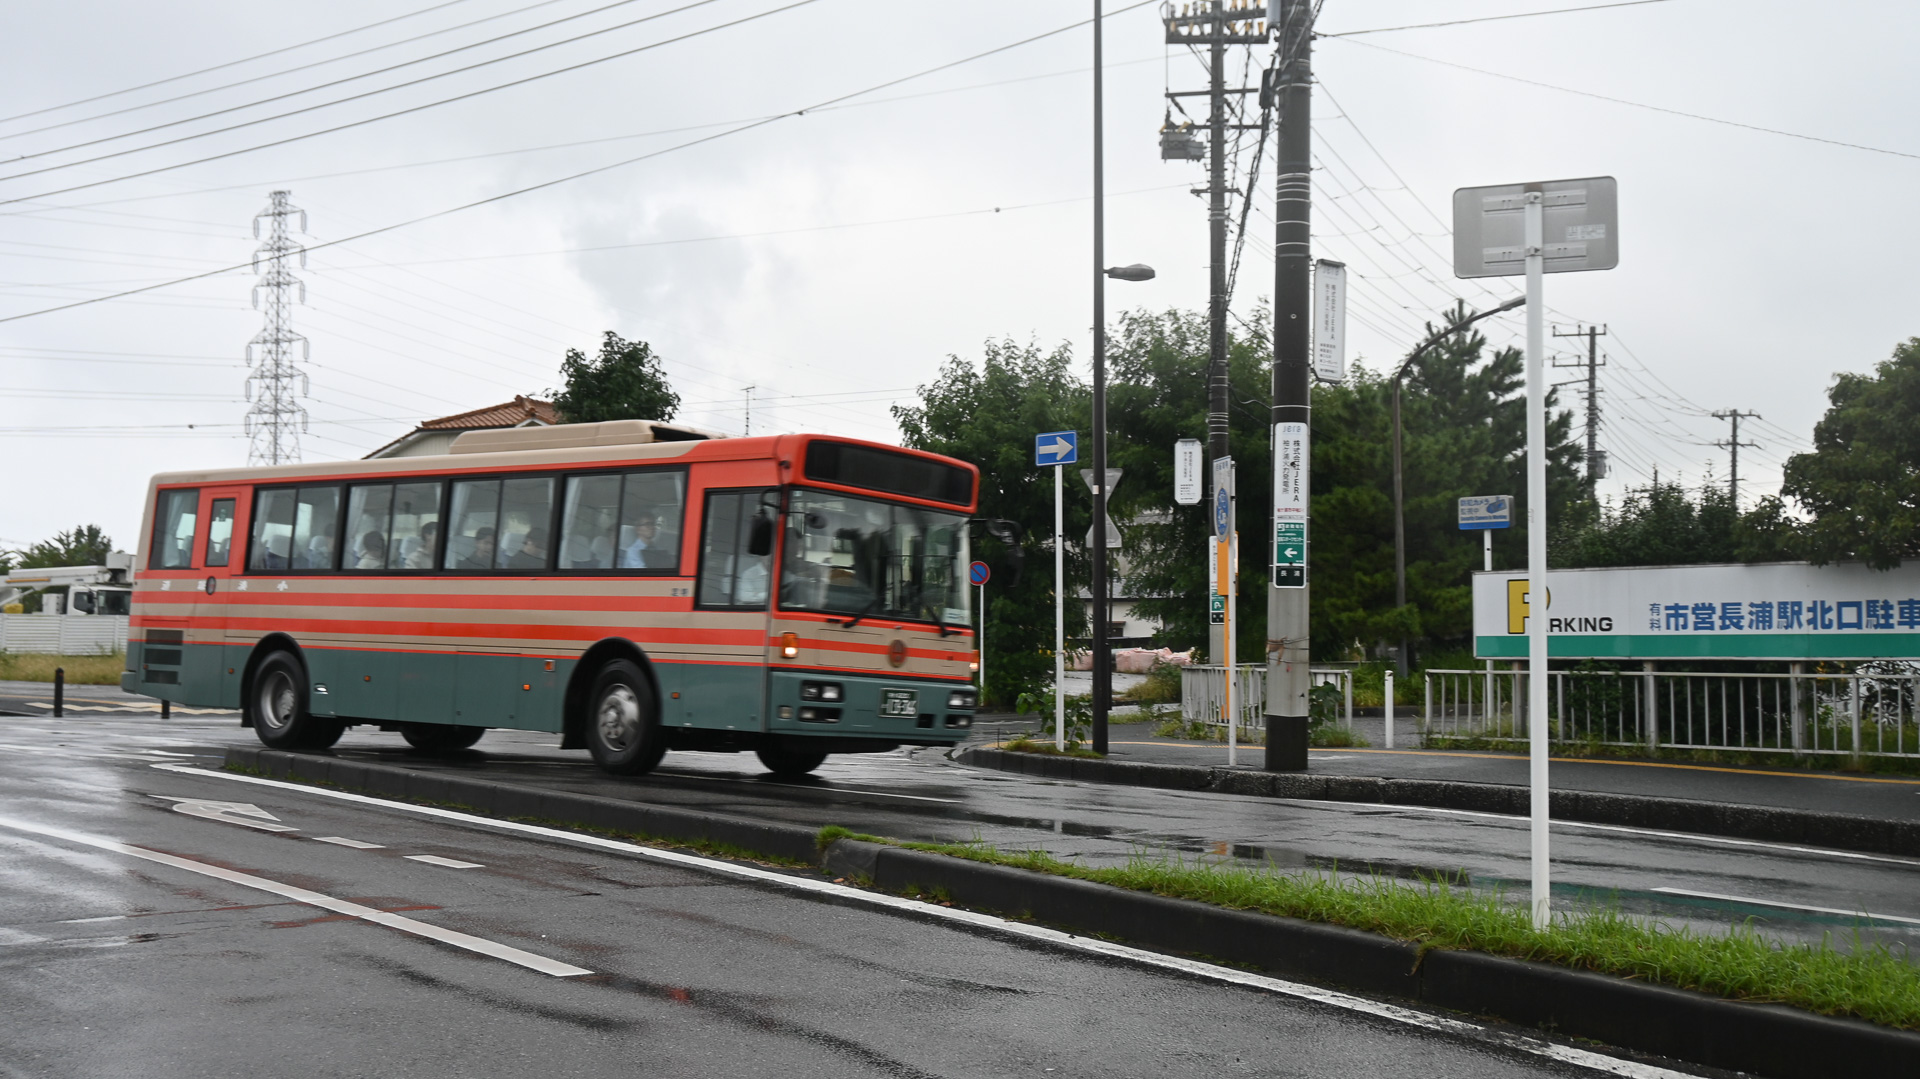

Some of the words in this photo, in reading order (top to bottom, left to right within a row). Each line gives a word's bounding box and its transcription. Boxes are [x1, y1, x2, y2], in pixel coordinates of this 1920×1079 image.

[1649, 602, 1662, 632] 有料
[1664, 598, 1920, 632] 市営長浦駅北口駐車
